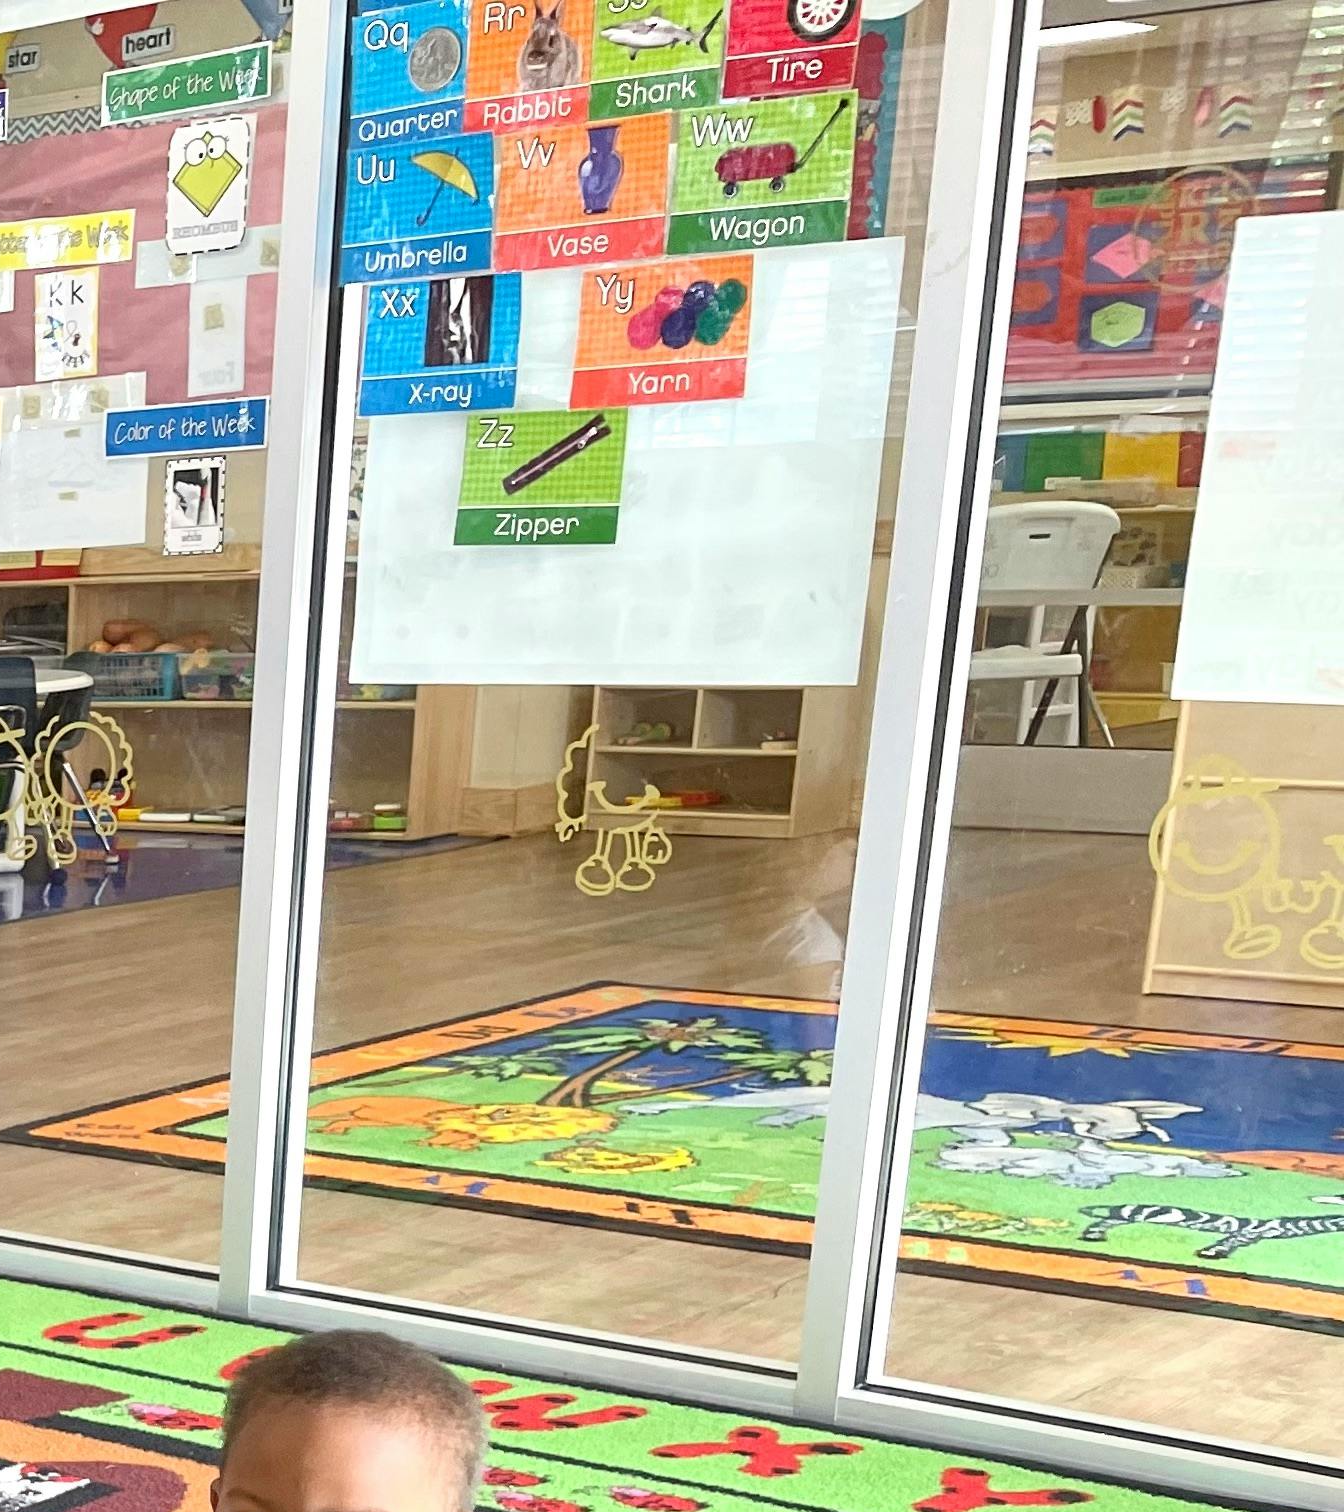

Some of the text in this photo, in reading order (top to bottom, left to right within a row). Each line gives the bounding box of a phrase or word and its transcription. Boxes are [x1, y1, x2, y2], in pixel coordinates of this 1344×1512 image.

[483, 1, 526, 34] Rr
[125, 27, 172, 54] heart
[363, 19, 410, 54] Qq
[7, 50, 38, 68] star
[767, 57, 823, 84] Tire
[110, 86, 159, 112] Shape
[163, 77, 181, 100] of
[186, 73, 213, 95] the
[614, 77, 697, 109] Shark
[357, 108, 457, 142] Quarter
[483, 96, 572, 126] Rabbit
[691, 114, 754, 148] Ww
[517, 139, 556, 169] Vv
[356, 156, 395, 185] Uu
[547, 232, 609, 257] Vase
[709, 215, 805, 247] Wagon
[364, 242, 467, 273] Umbrella
[380, 288, 417, 318] Xx
[596, 275, 635, 313] Yy
[408, 382, 472, 408] X-ray
[629, 371, 690, 396] Yarn
[115, 414, 256, 445] Color of the Week
[476, 419, 516, 449] Zz
[494, 513, 580, 541] Zipper
